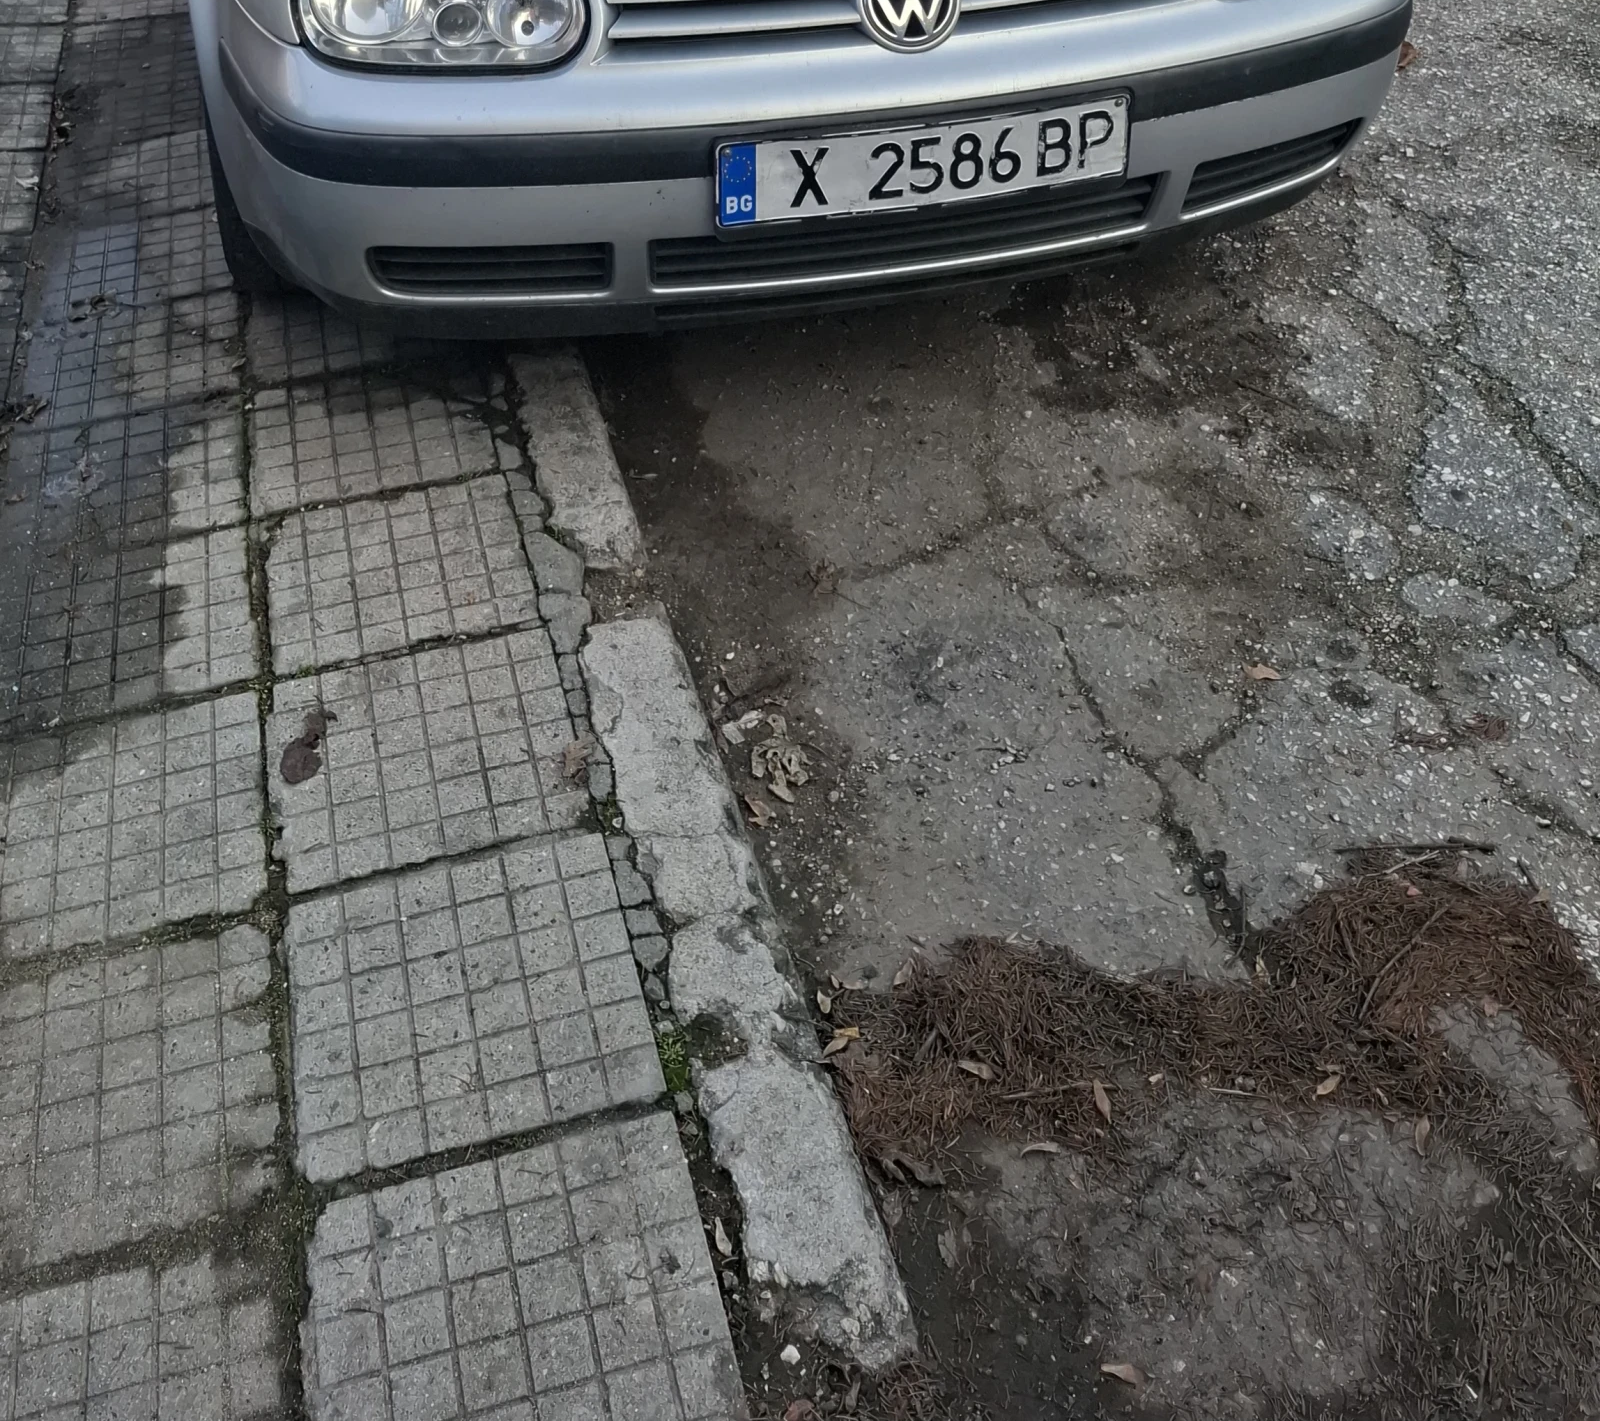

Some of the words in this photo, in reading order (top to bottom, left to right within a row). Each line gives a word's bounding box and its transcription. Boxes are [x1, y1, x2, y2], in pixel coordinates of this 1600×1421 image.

[790, 147, 829, 208] X
[868, 127, 1022, 201] 2586
[1036, 110, 1114, 177] BP
[726, 195, 753, 214] BG
